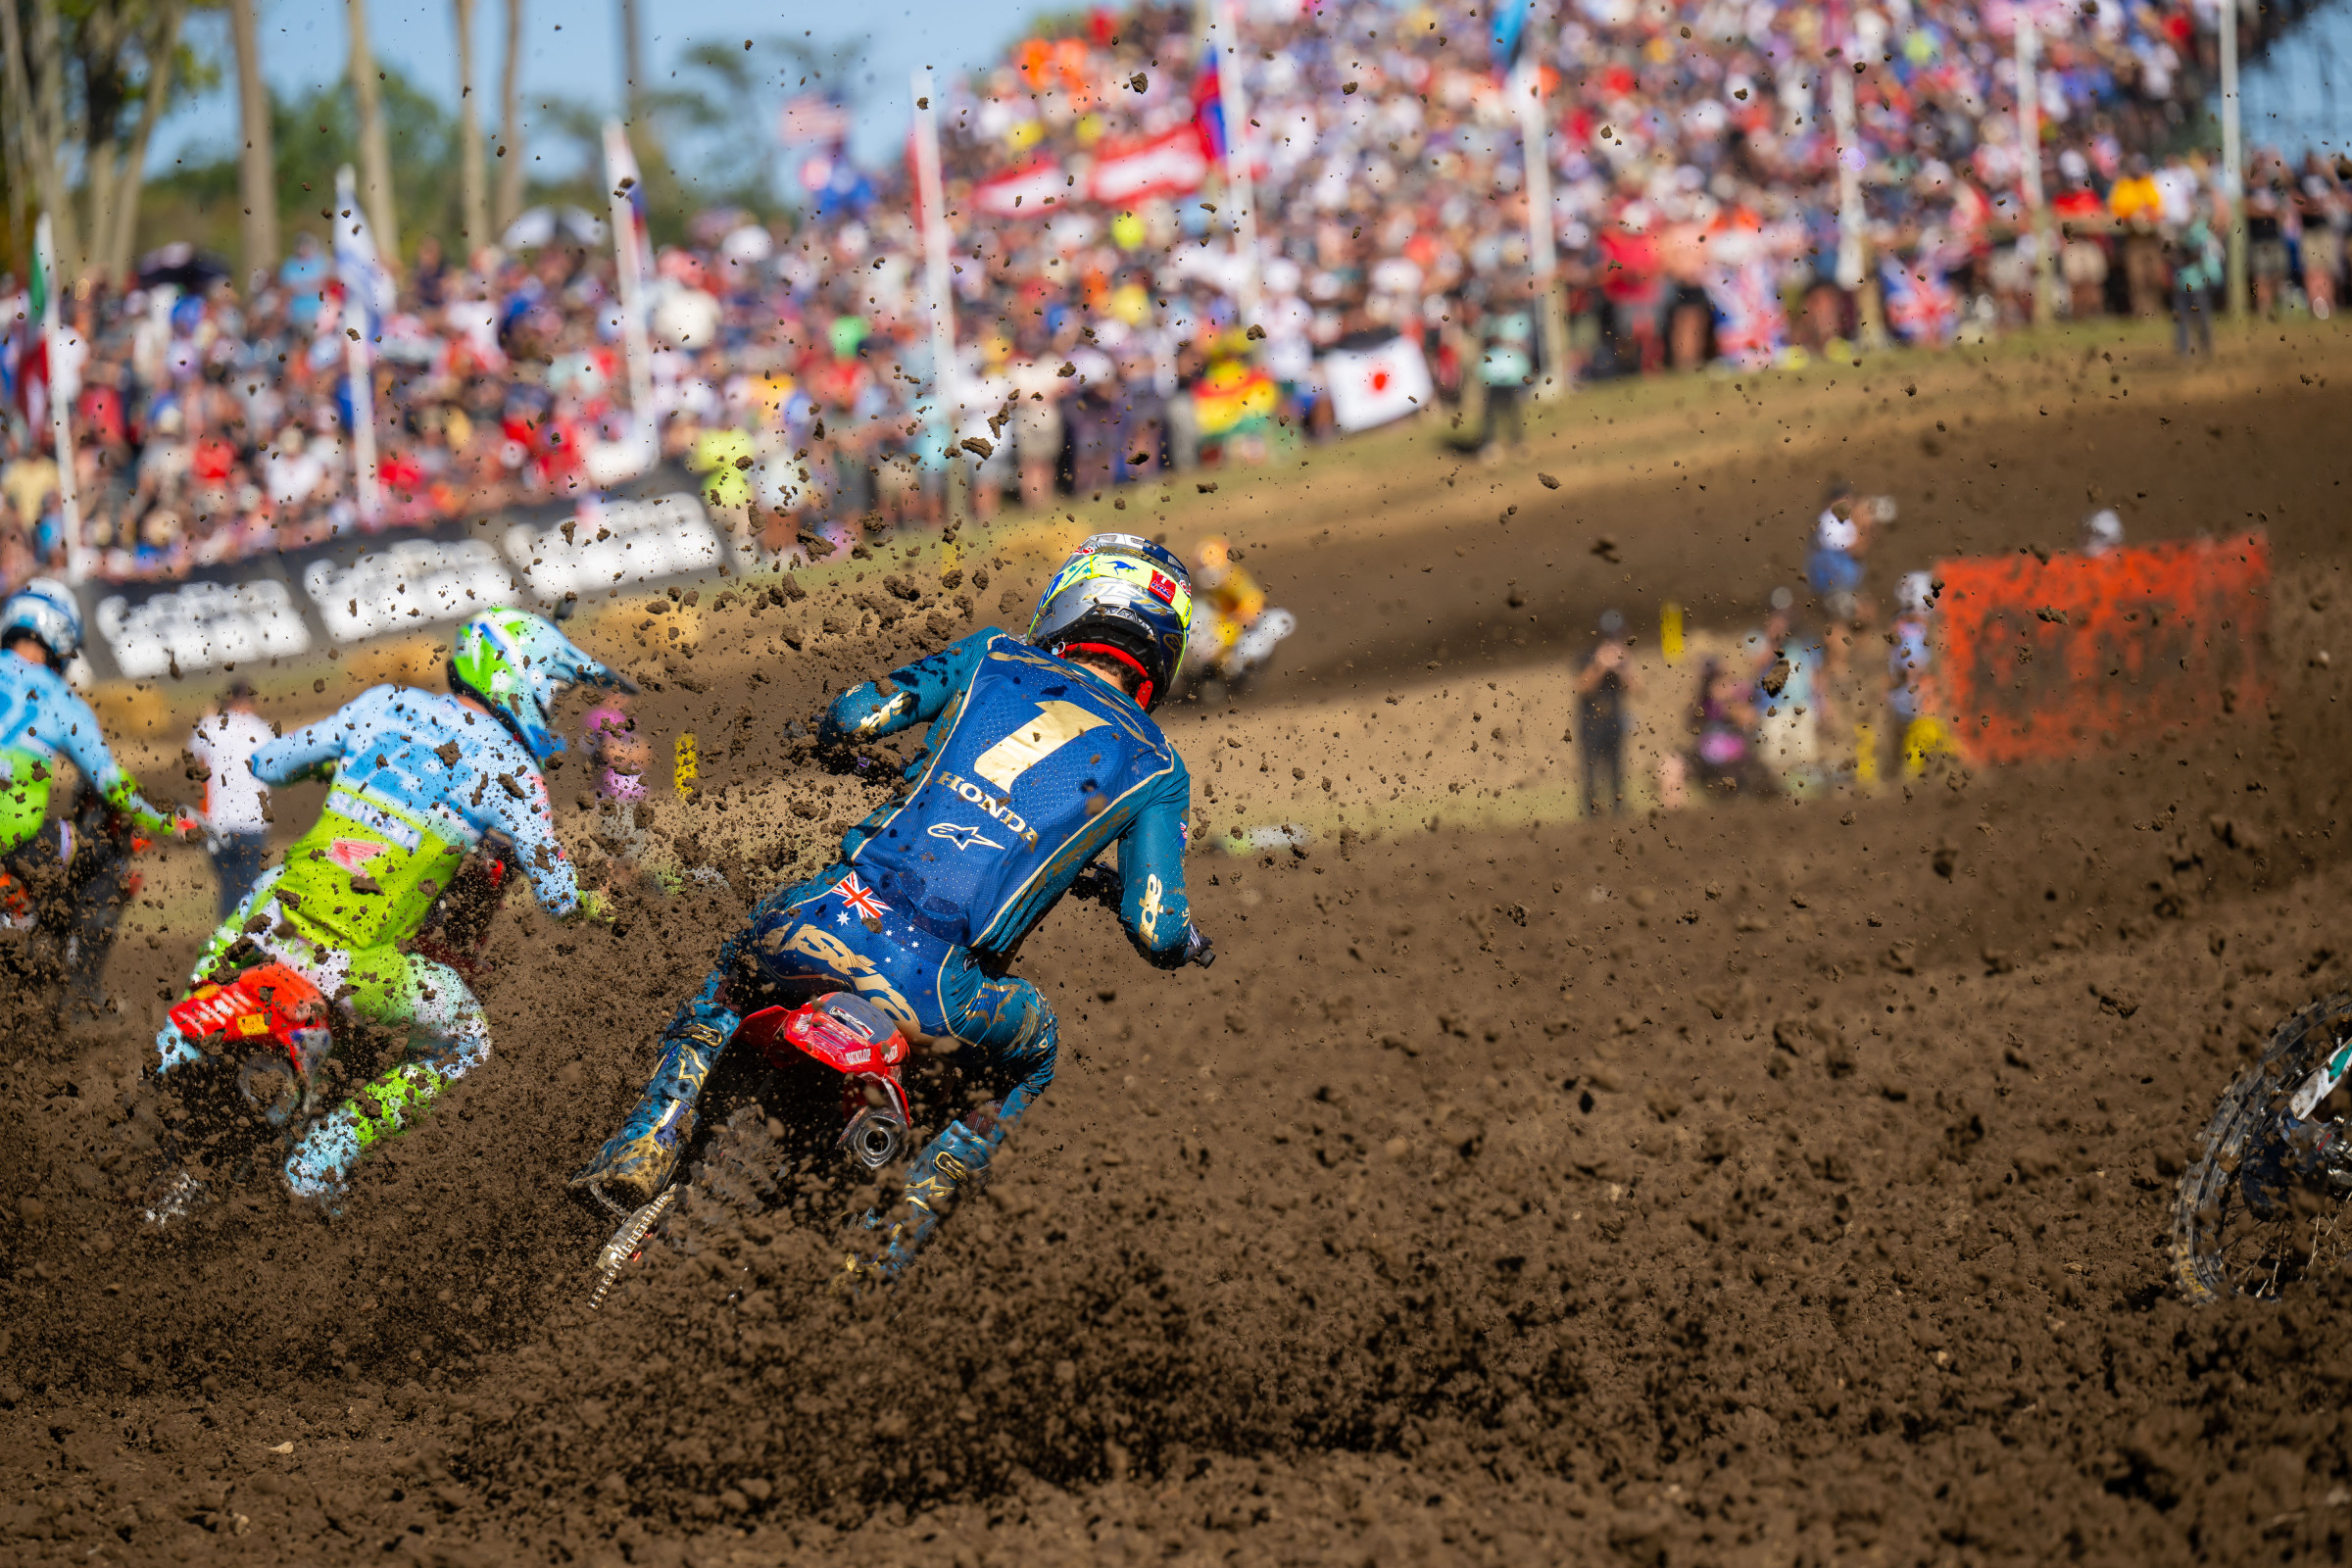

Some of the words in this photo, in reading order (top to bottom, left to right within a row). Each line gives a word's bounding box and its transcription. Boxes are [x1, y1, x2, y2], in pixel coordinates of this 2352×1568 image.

[974, 700, 1113, 795] 1
[935, 770, 1039, 854] HONDA
[845, 1048, 872, 1065] DUNLOP
